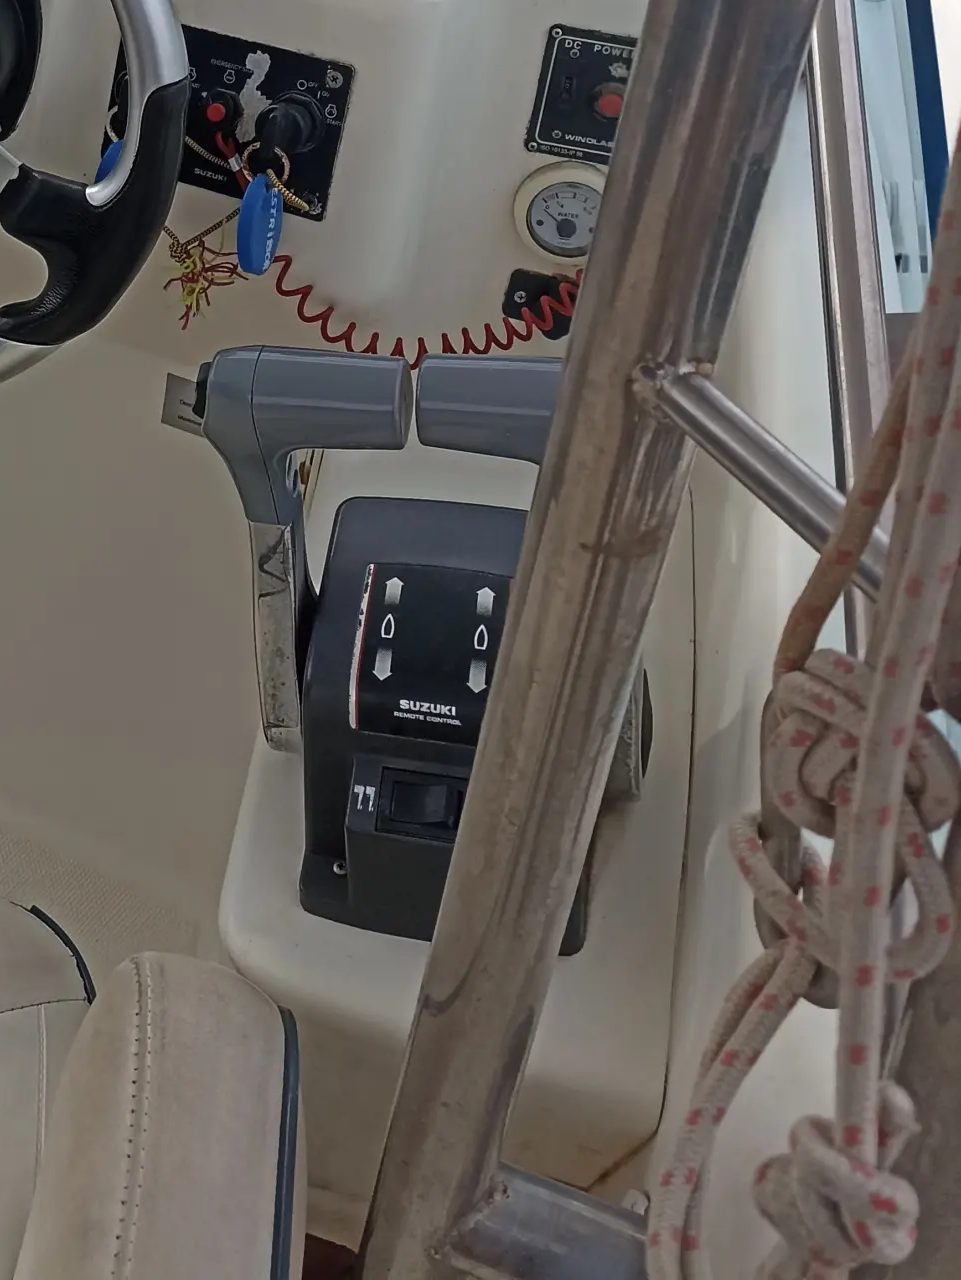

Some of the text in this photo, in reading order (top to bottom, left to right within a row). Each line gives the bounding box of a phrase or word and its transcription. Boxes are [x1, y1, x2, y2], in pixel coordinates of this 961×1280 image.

[564, 39, 582, 50] DC
[210, 58, 242, 71] EMERGENCY
[564, 133, 616, 148] WINDLAS
[193, 167, 228, 182] SUZUKI
[557, 211, 579, 219] WATER
[399, 699, 457, 716] SUZUKI
[393, 711, 462, 726] REMOTE CONTROL
